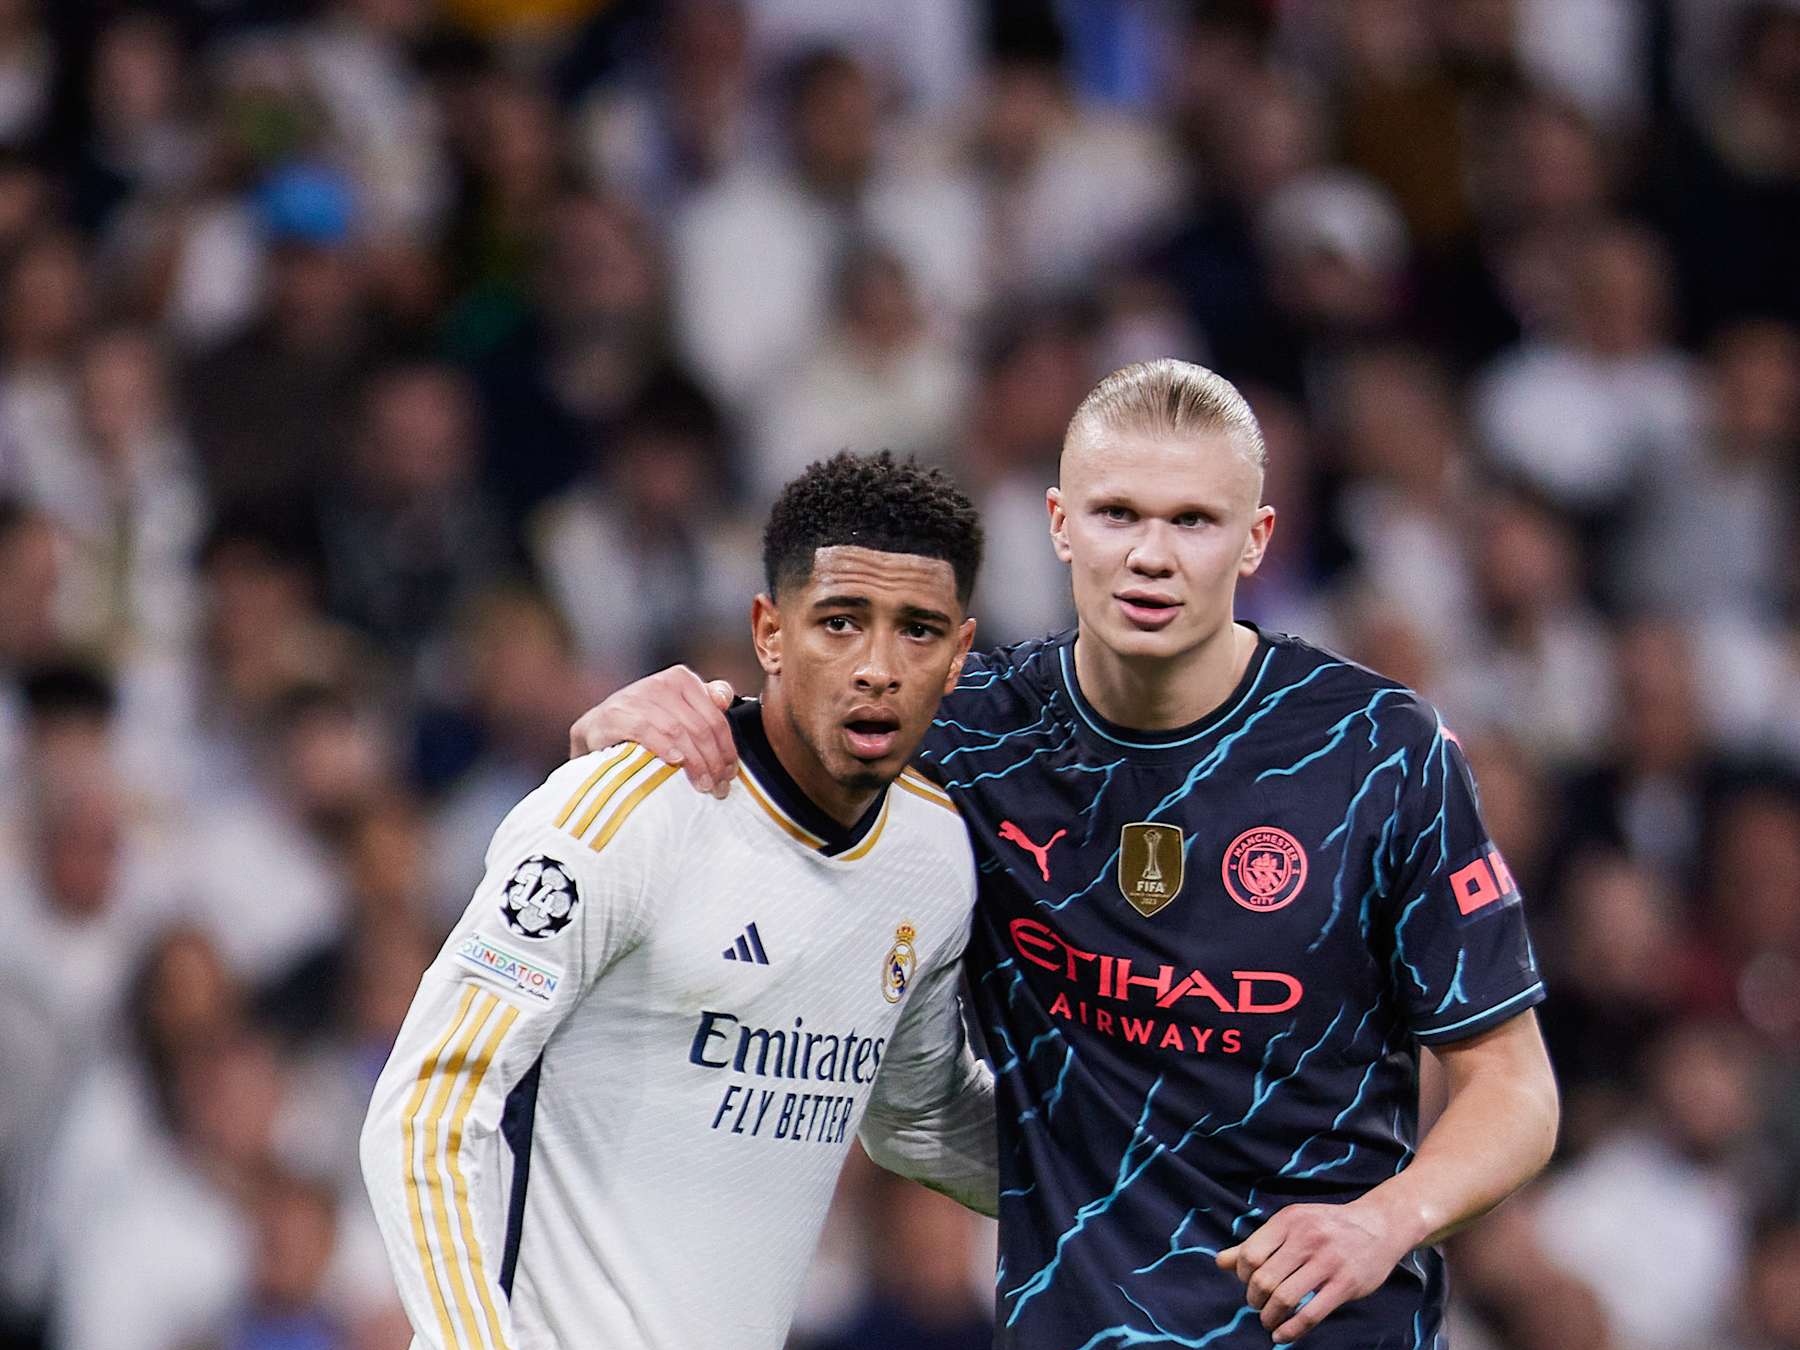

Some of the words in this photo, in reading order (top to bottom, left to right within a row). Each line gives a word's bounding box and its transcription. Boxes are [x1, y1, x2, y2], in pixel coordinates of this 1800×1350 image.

[1233, 833, 1299, 862] MANCHESTER
[1136, 881, 1165, 893] FIFA
[1249, 895, 1276, 905] CITY
[460, 941, 558, 992] OUNDATION
[1009, 918, 1304, 1014] ETIHAD
[688, 1010, 885, 1084] Emirates
[1049, 991, 1242, 1053] AIRWAYS
[711, 1085, 775, 1136] FLY
[774, 1093, 854, 1143] BETTER
